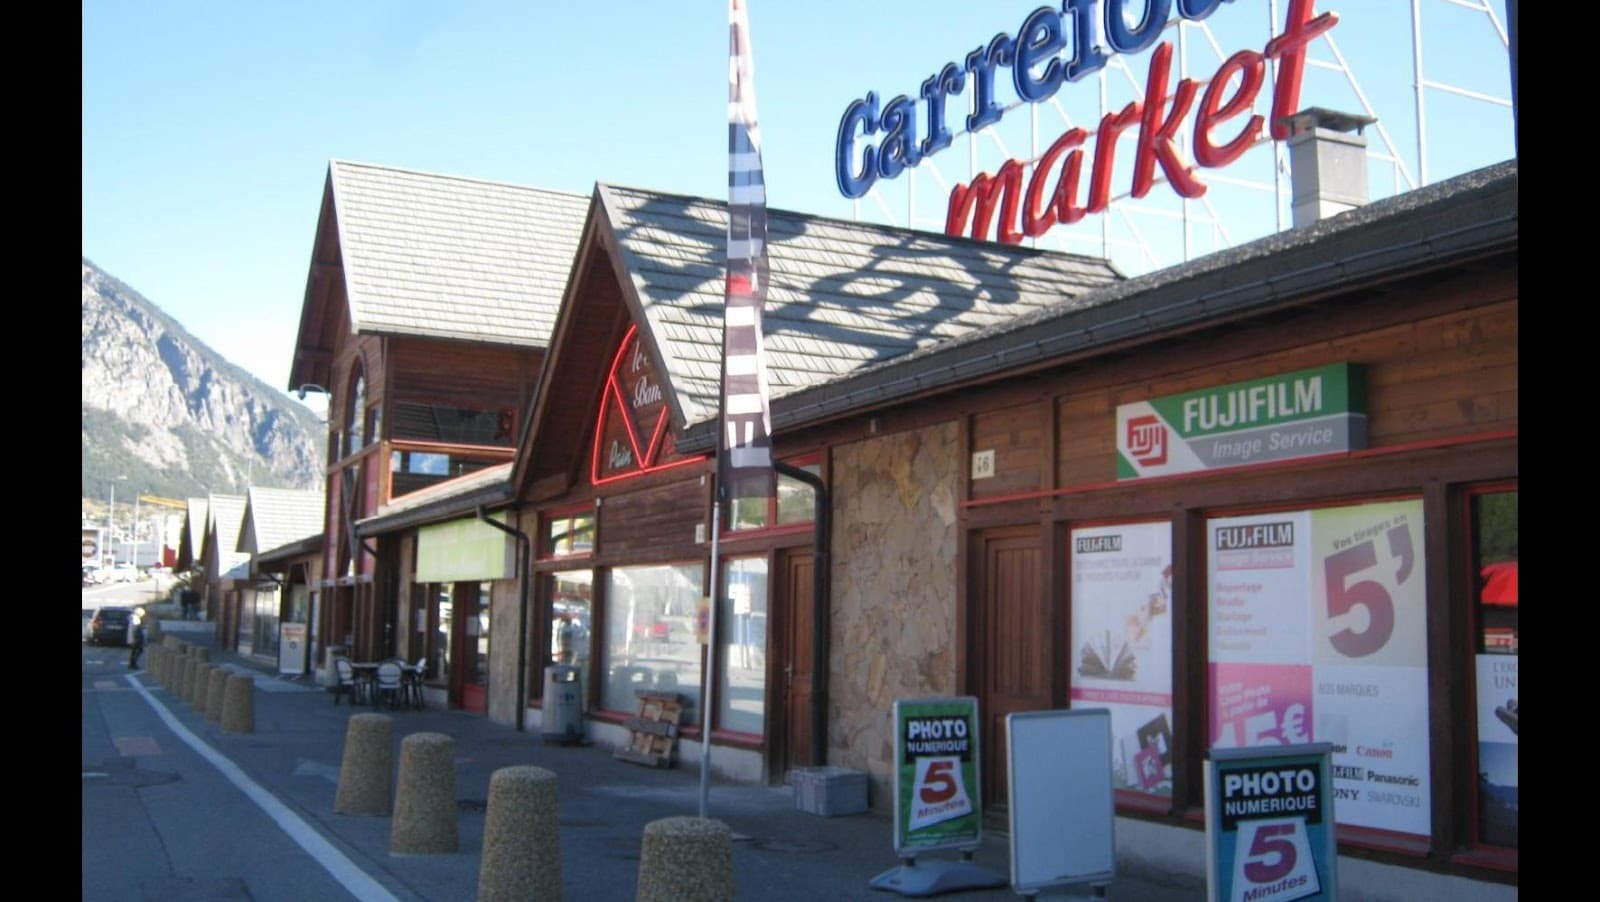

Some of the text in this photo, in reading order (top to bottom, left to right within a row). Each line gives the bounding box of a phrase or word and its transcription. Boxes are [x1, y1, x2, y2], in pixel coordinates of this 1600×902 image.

[836, 0, 1236, 199] Carrefo
[945, 0, 1339, 244] market
[1184, 376, 1322, 432] FUJIFILM
[1213, 427, 1333, 459] Image Service
[1078, 536, 1121, 553] FUJIFILM
[1217, 524, 1293, 549] FUJIFILM
[1336, 682, 1379, 697] MARQUES
[908, 719, 967, 739] PHOTO
[907, 740, 968, 753] NUMERIQUE
[1356, 745, 1392, 759] Canon
[920, 761, 957, 805] 5
[1224, 769, 1315, 797] PHOTO
[1367, 770, 1419, 787] Panasonic
[1225, 795, 1316, 815] NUMERIQUE
[1244, 823, 1297, 884] 5
[1243, 875, 1308, 902] Minutes
